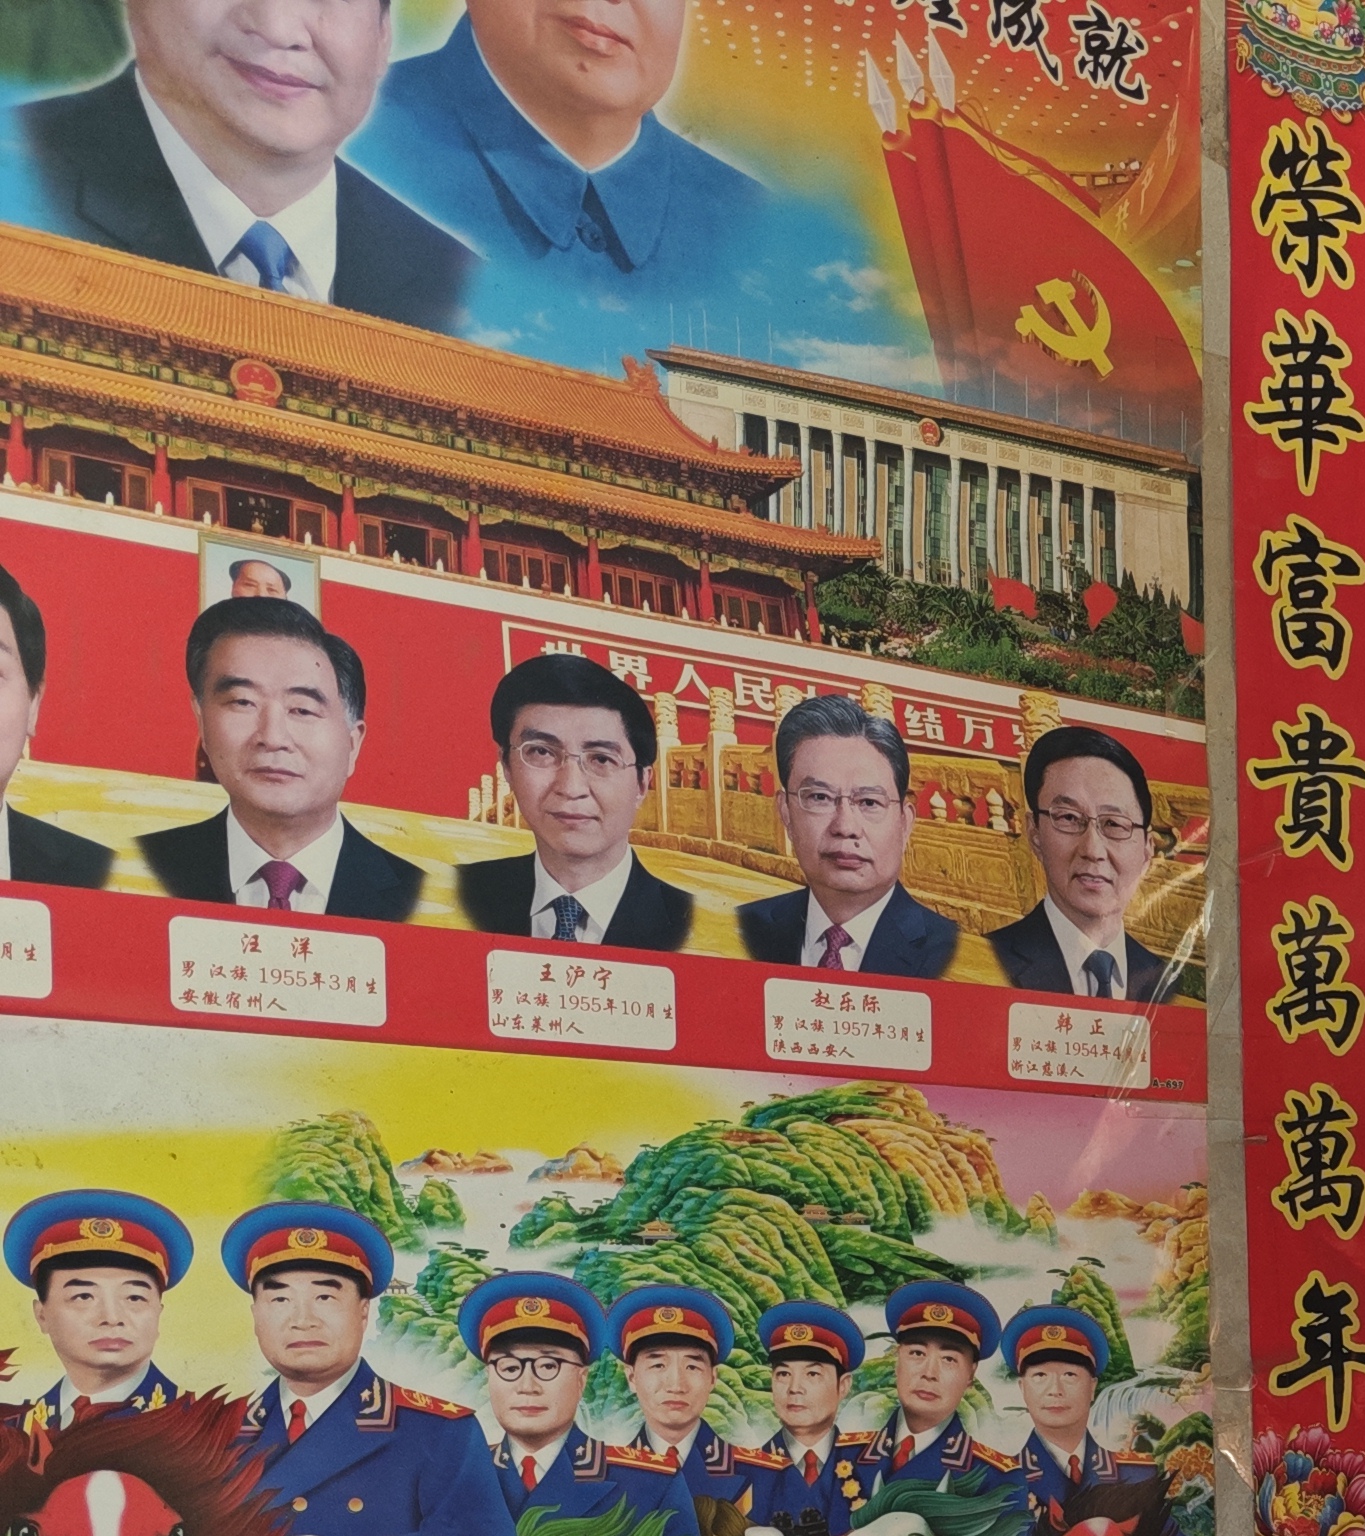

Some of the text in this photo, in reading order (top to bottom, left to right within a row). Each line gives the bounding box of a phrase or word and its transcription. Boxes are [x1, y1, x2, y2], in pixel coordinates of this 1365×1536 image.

[241, 933, 313, 963] 汪洋
[181, 961, 379, 996] 男 汉族 1955年3月生
[539, 963, 612, 991] 王沪宁
[178, 987, 288, 1013] 安徽宿州人
[491, 988, 674, 1021] 男 汉族 1955年10月生
[810, 988, 882, 1014] 赵乐际
[491, 1014, 585, 1036] 山东莱州人
[773, 1014, 926, 1045] 男 汉族 1957年3月生
[1055, 1012, 1105, 1036] 韩正
[772, 1037, 856, 1060] 陕西西安人
[1012, 1037, 1022, 1052] 男
[1031, 1039, 1057, 1054] 汉族
